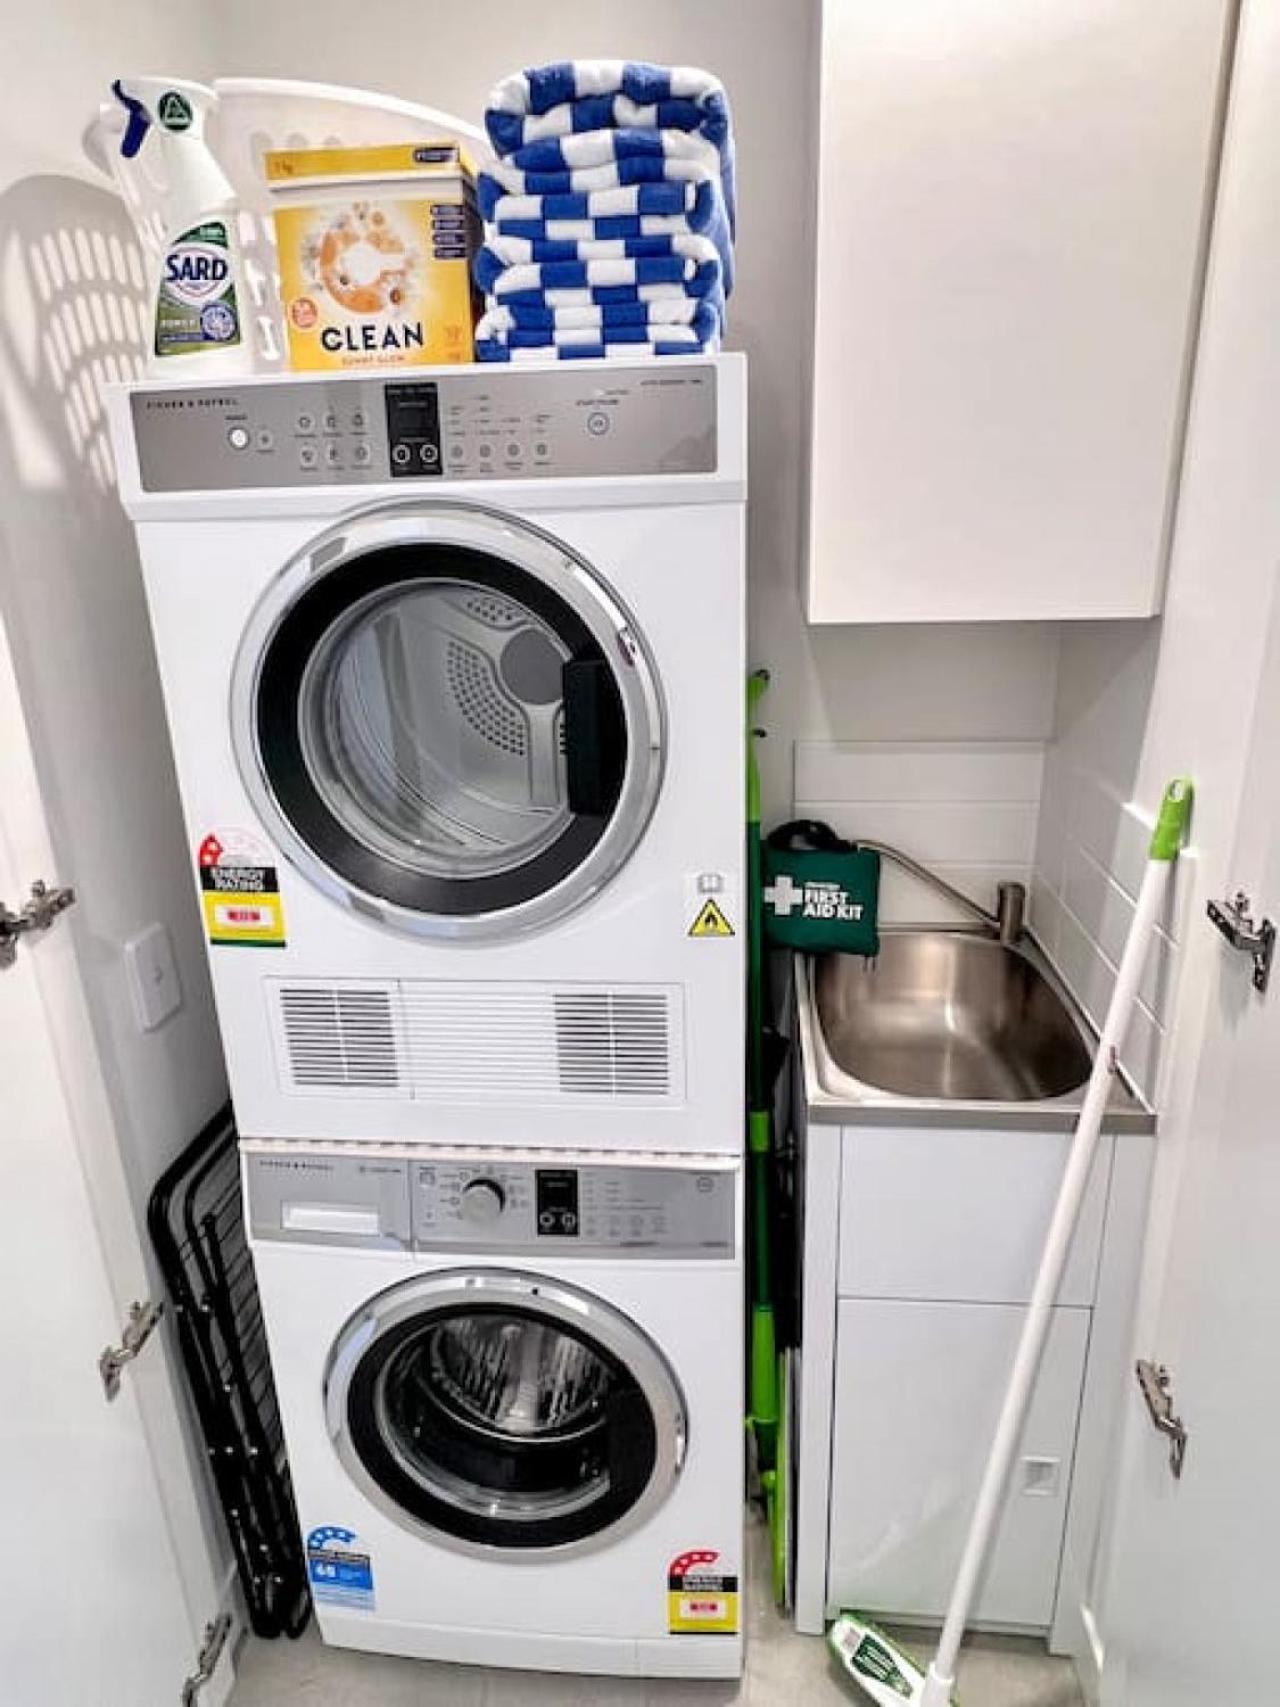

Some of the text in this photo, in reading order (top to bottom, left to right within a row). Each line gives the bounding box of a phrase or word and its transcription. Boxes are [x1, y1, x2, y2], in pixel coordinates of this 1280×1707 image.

[166, 254, 228, 282] SARD
[321, 322, 423, 351] CLEAN
[804, 889, 850, 905] FIRST
[802, 902, 864, 921] AID KIT
